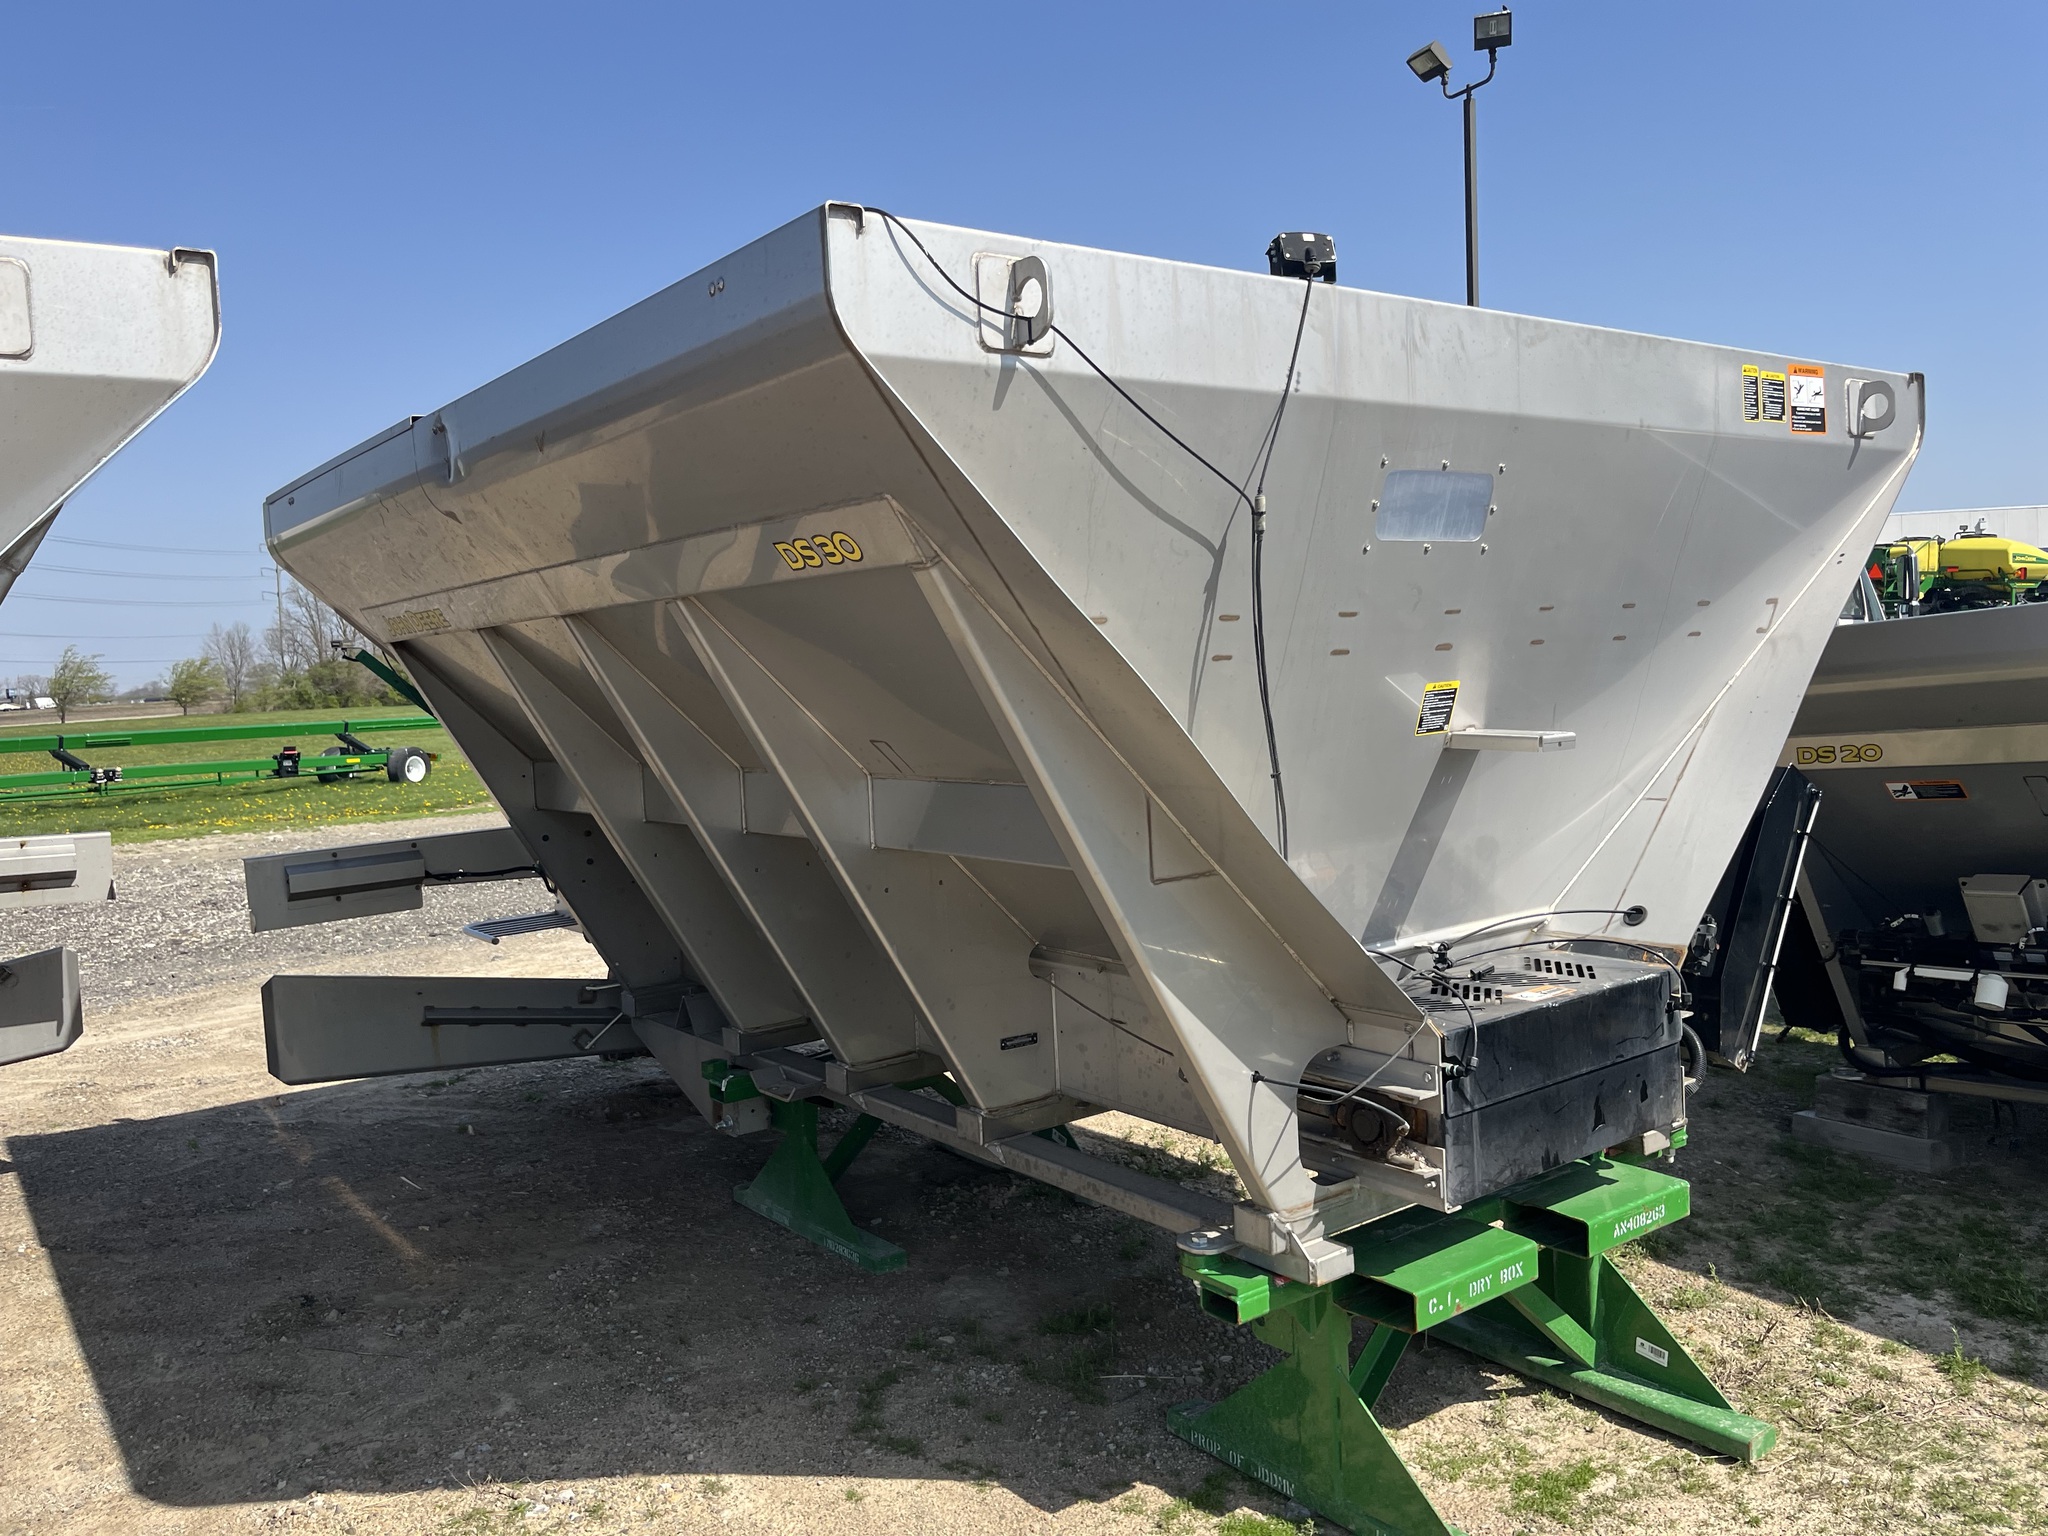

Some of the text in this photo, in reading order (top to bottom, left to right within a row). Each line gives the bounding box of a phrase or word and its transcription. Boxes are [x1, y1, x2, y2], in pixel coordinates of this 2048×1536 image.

[1798, 367, 1818, 375] WARNING
[405, 607, 452, 632] DEERE
[1469, 1274, 1493, 1298] DRY
[1500, 1261, 1524, 1285] BOX
[1190, 1429, 1221, 1455] PROP
[1229, 1450, 1245, 1468] OF
